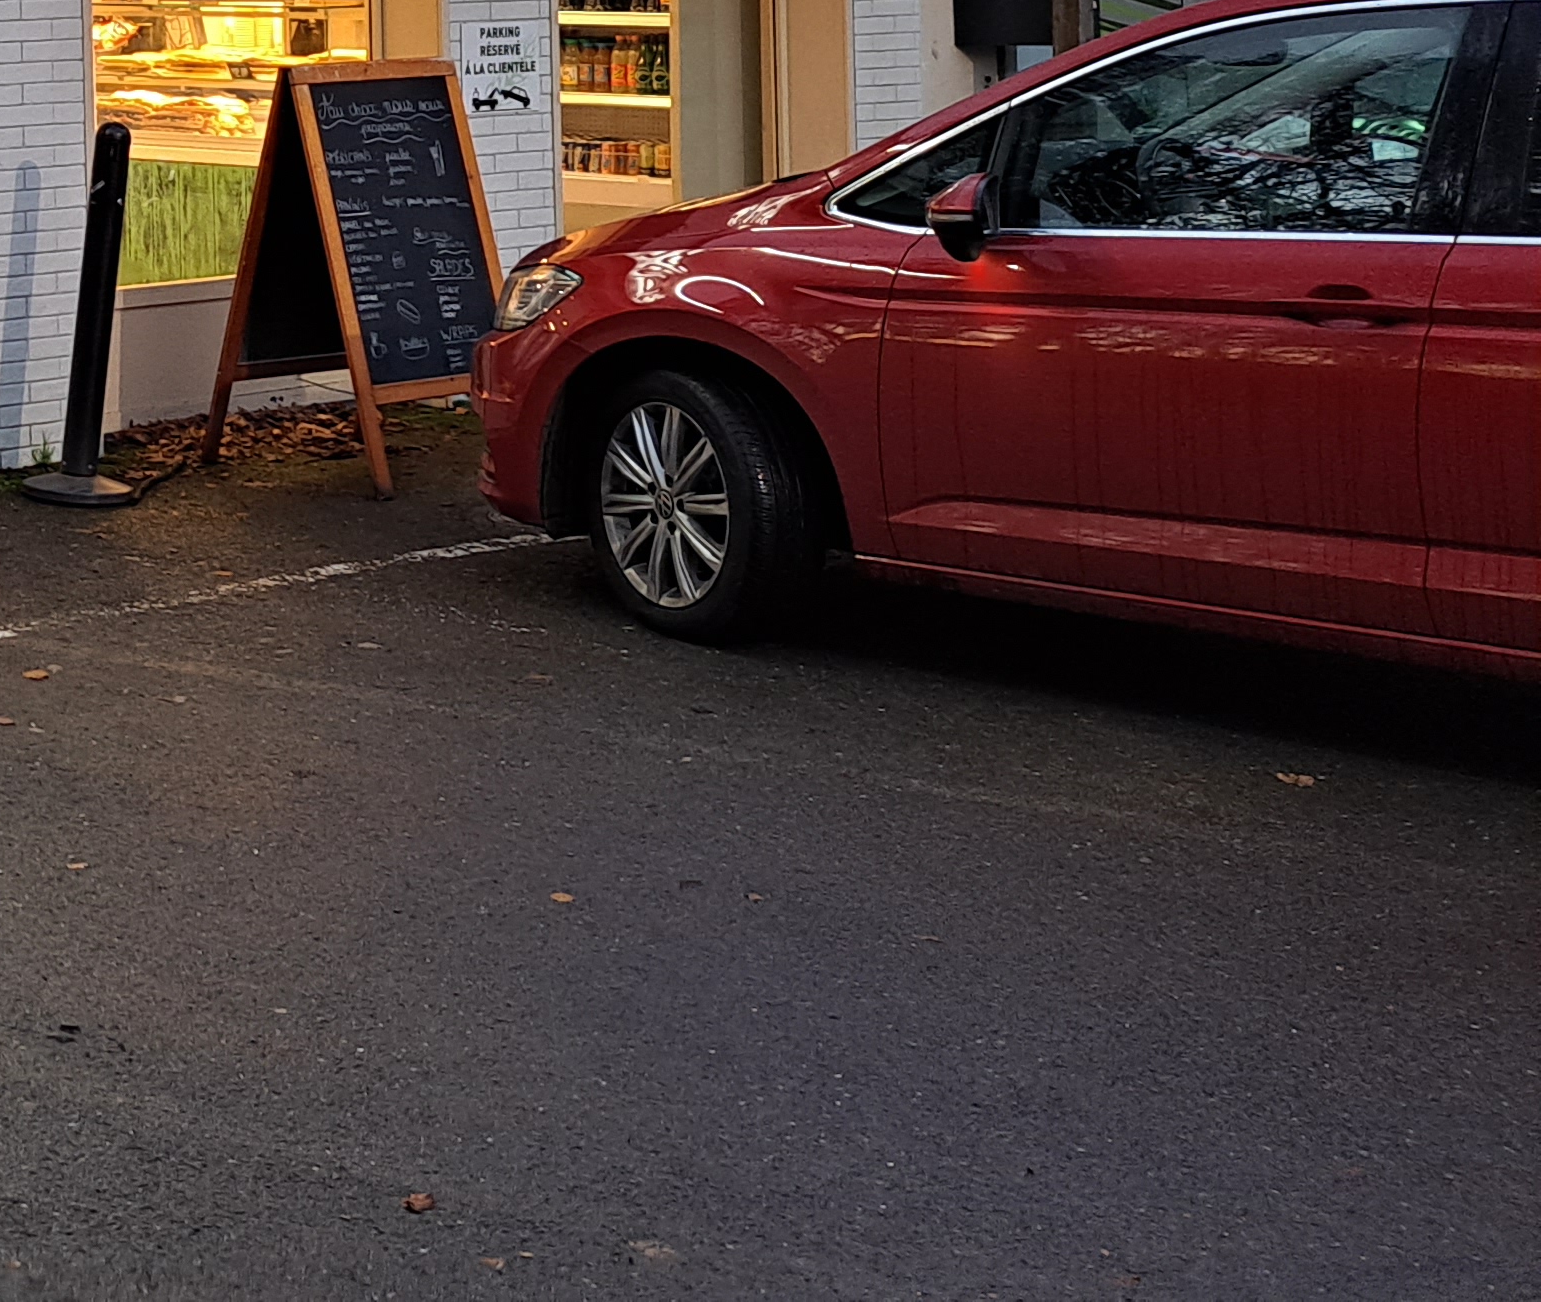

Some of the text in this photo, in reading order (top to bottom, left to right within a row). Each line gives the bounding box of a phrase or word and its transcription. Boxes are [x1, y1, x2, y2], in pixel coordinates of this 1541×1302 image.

[479, 26, 521, 39] PARKING
[479, 40, 521, 57] RÉSERVÉ
[473, 62, 485, 75] LA
[487, 58, 536, 74] CLIENTÈLE
[440, 324, 478, 341] WRAPS
